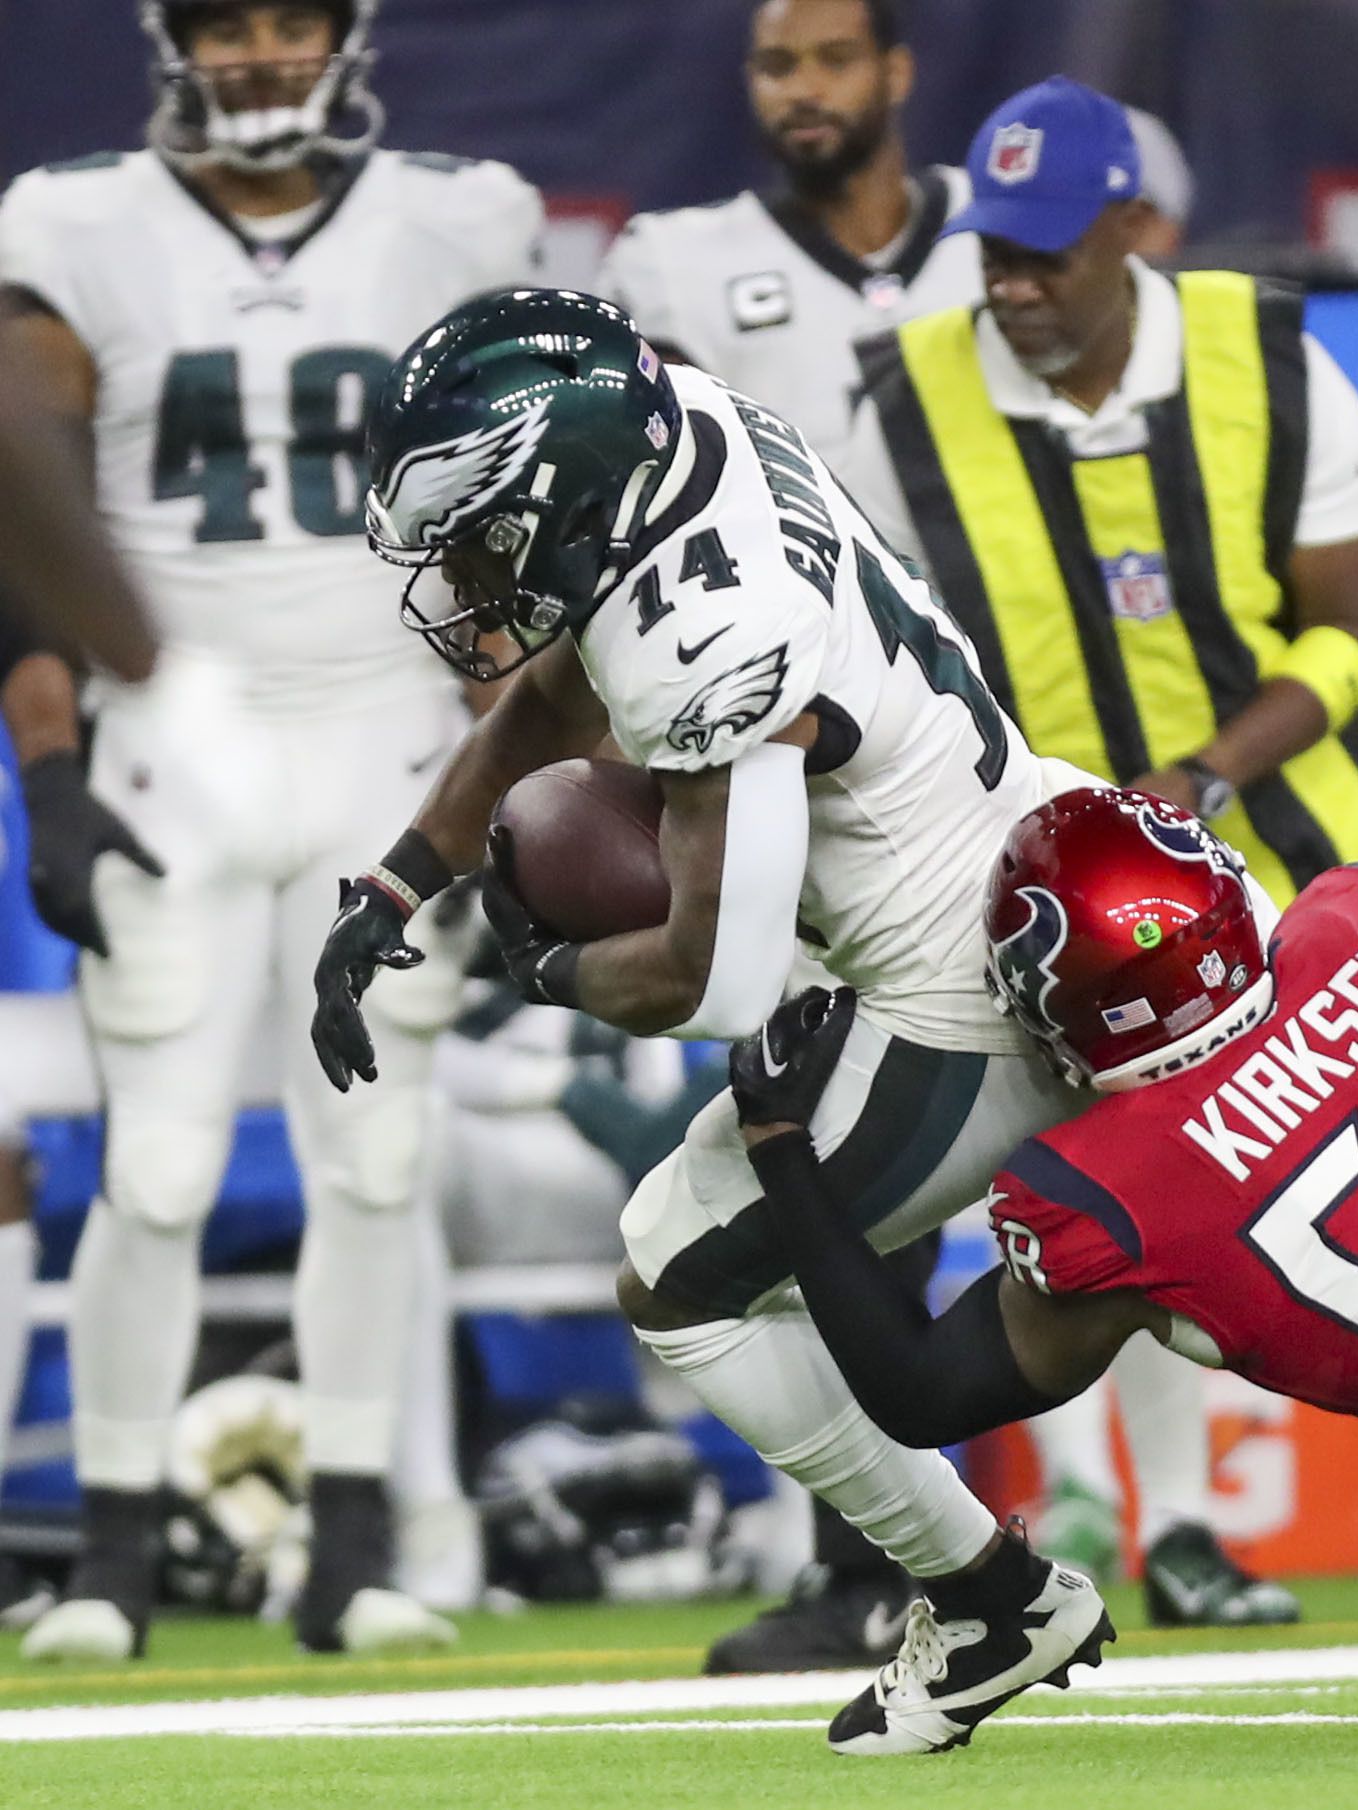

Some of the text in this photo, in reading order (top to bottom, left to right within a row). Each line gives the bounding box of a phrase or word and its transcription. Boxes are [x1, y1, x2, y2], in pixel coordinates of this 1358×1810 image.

[150, 346, 393, 543] 48
[628, 526, 741, 637] 14
[1138, 1005, 1258, 1081] TEXANS
